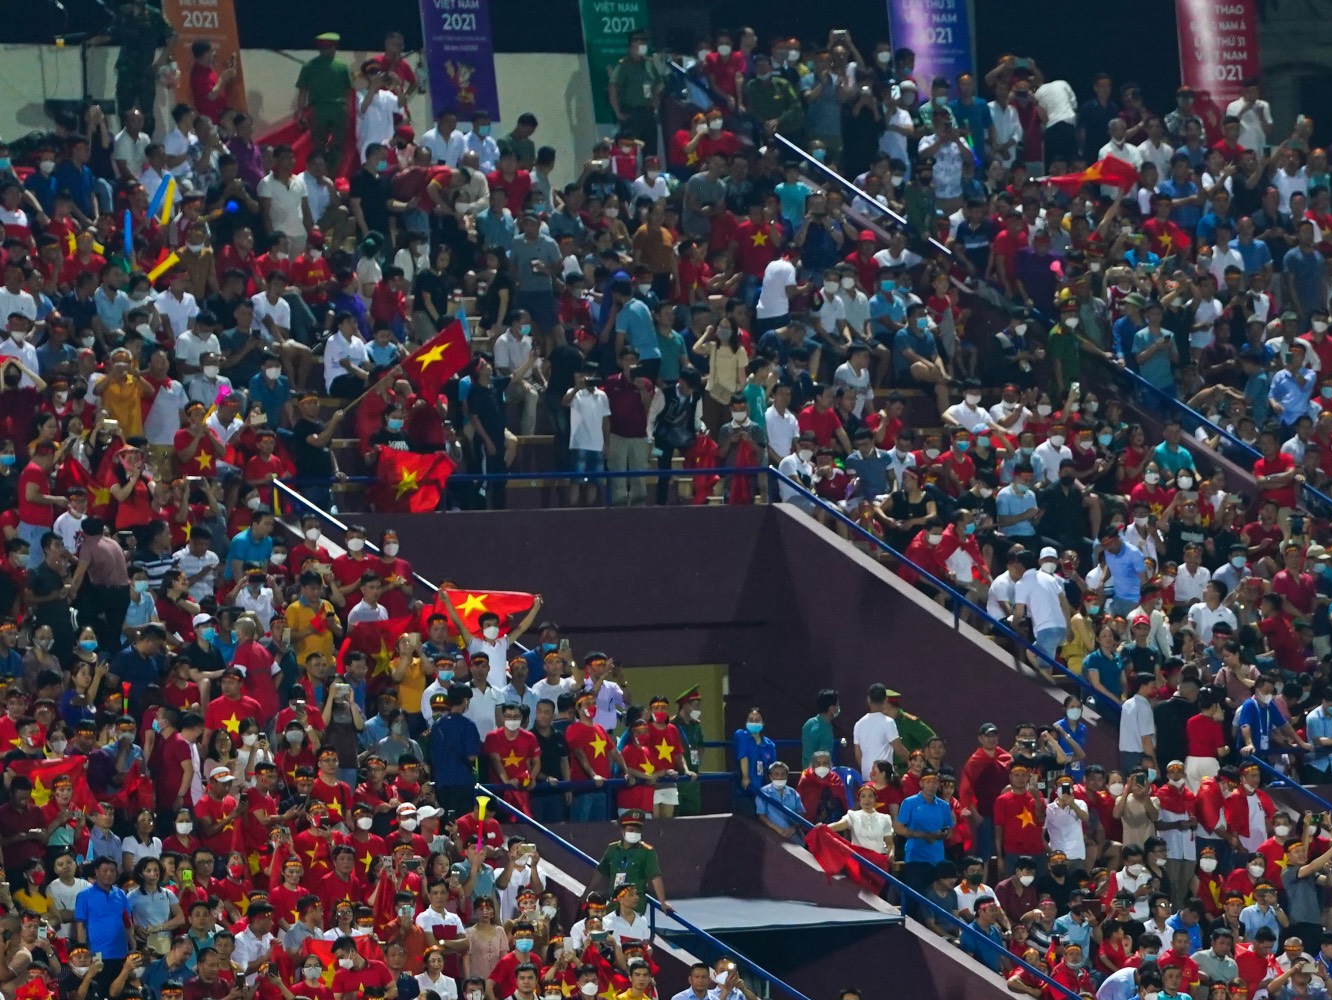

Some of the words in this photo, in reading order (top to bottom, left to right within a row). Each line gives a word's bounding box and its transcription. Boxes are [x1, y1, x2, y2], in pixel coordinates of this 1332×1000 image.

[182, 11, 218, 28] 2021
[442, 13, 476, 30] 2021
[602, 17, 635, 33] 2021
[932, 13, 957, 23] NAM
[1222, 51, 1248, 60] NAM
